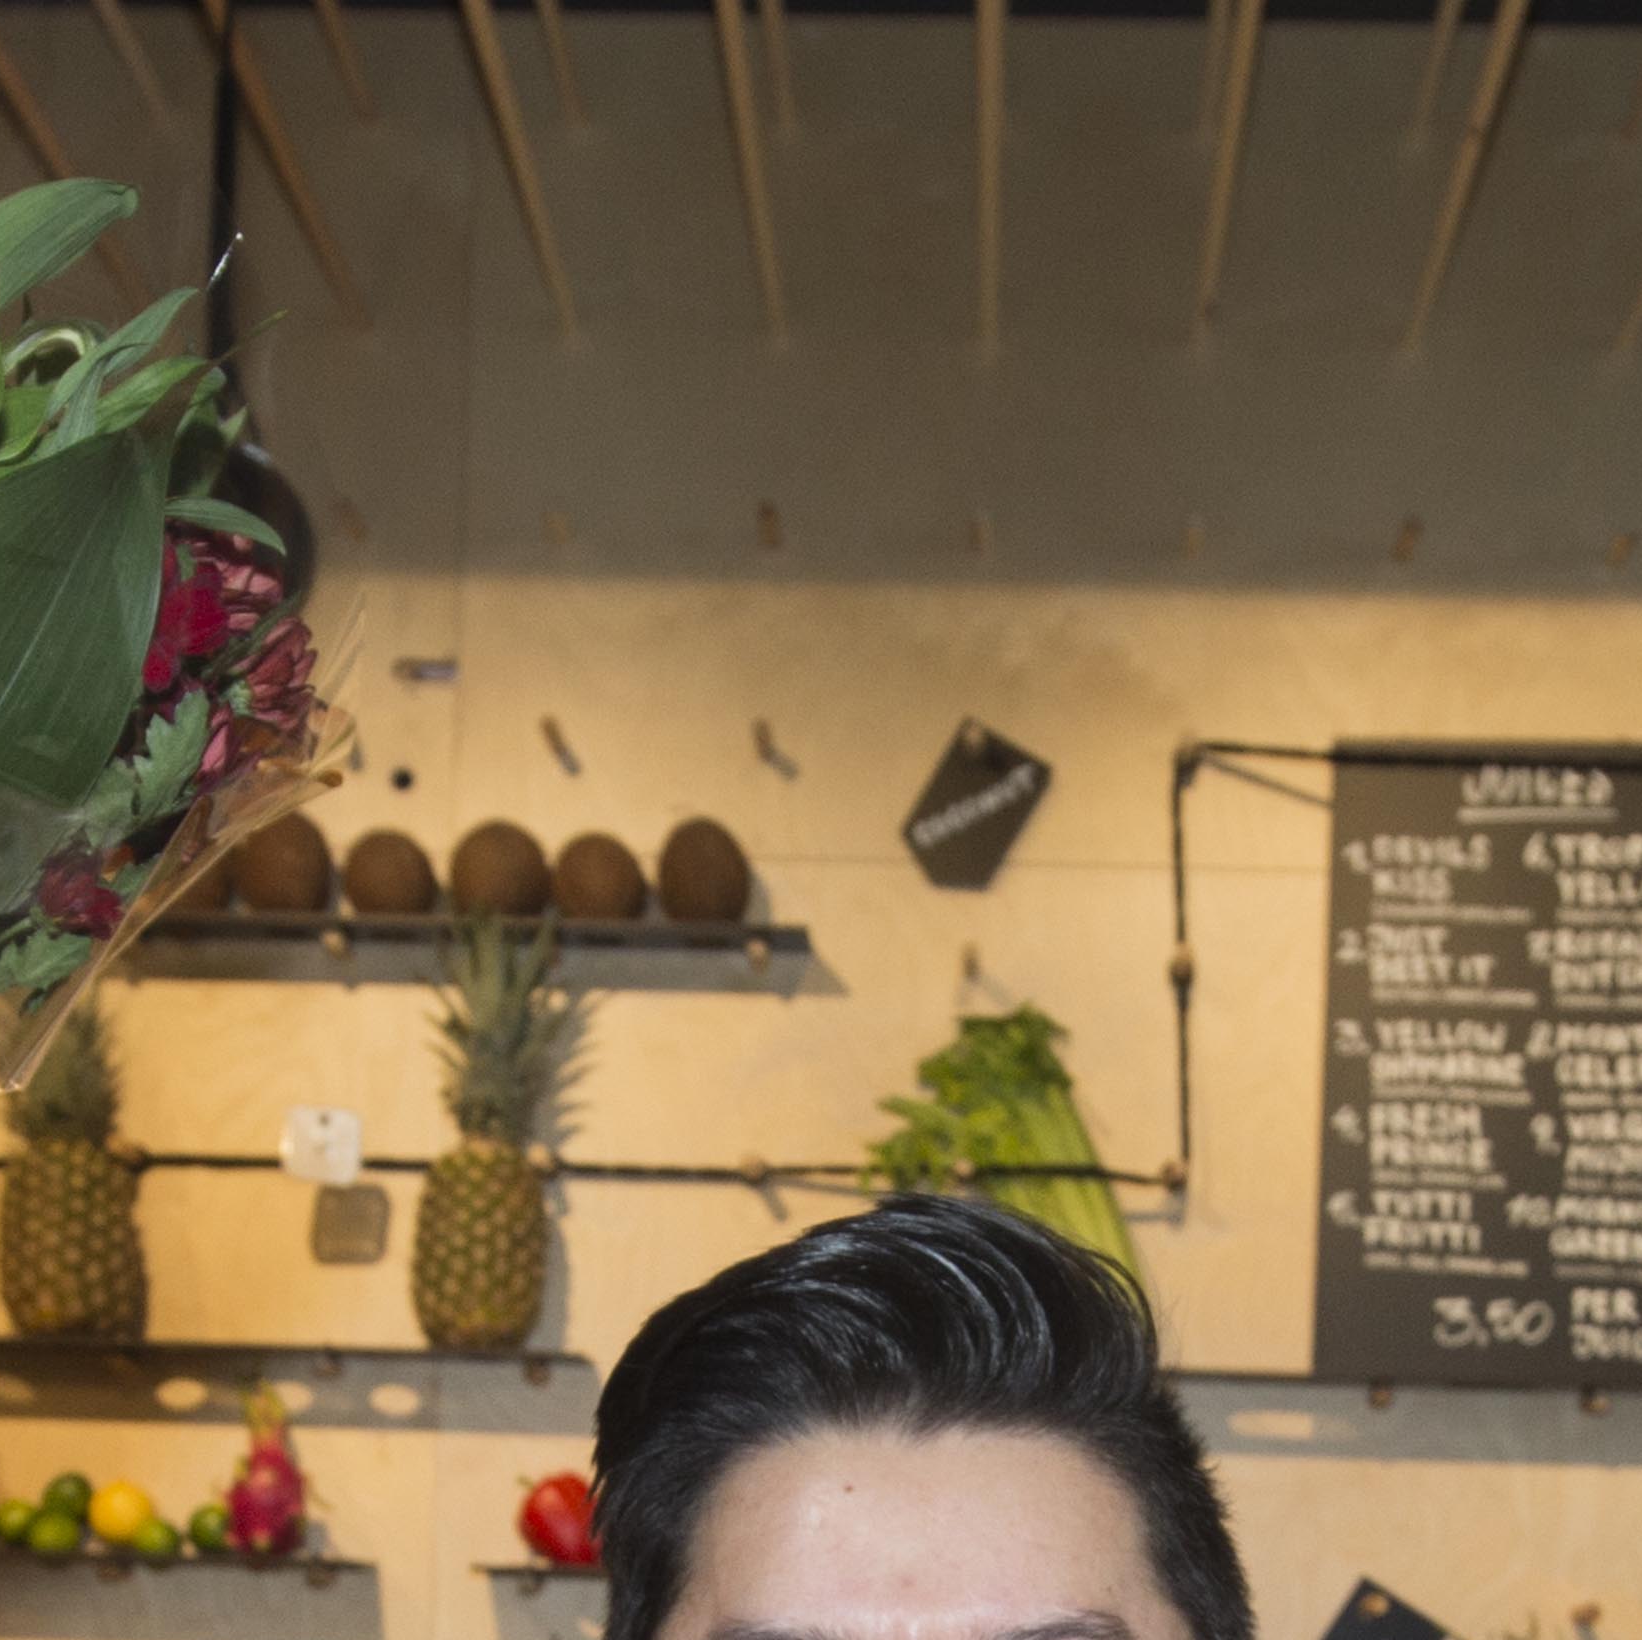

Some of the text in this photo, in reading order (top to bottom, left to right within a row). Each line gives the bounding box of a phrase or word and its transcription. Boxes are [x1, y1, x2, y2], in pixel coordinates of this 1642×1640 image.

[1459, 766, 1614, 805] JUICES
[1377, 1021, 1506, 1051] YELLOW
[1371, 1105, 1482, 1138] FRESH
[1371, 1138, 1493, 1171] PRINCE
[1372, 1192, 1473, 1222] TUTTI
[1363, 1222, 1481, 1252] FRUTTI
[1432, 1289, 1640, 1350] 3,50 PER
